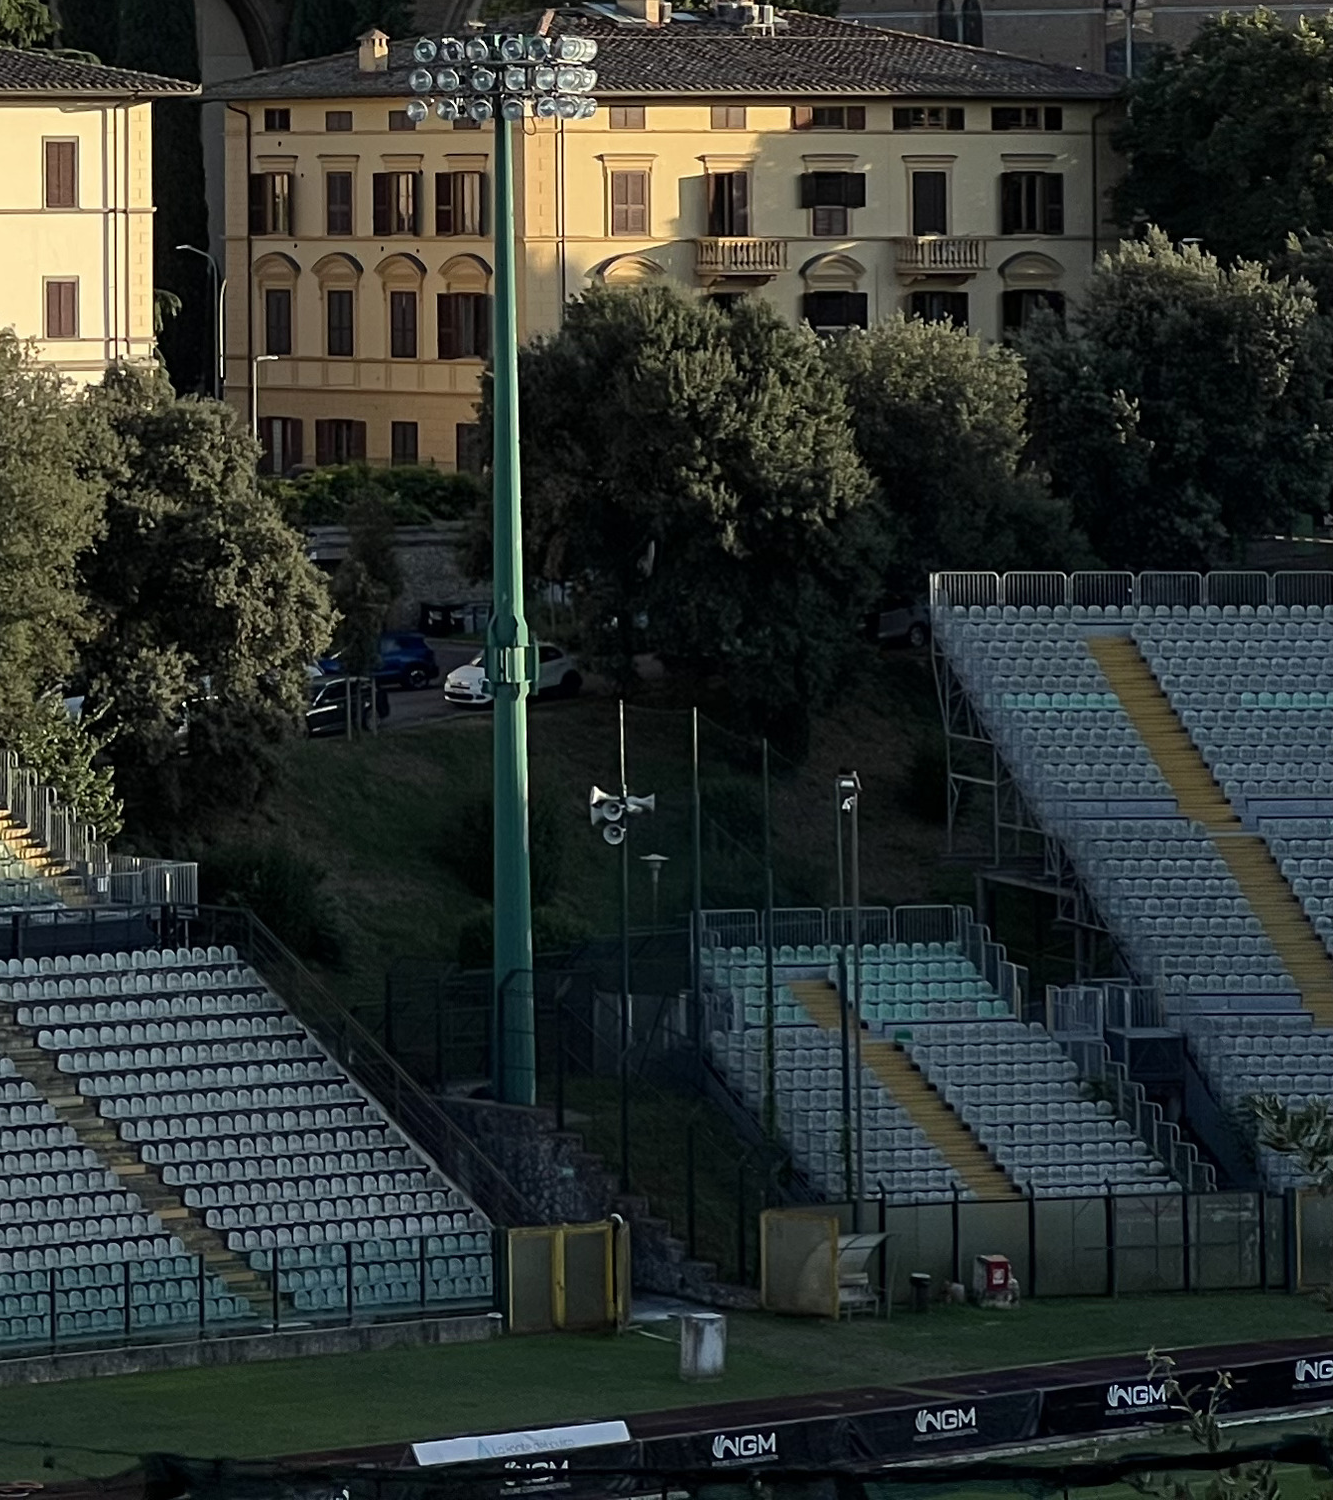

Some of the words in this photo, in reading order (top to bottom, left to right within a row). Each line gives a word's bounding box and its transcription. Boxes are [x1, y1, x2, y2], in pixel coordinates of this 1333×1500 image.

[1106, 1384, 1167, 1408] NGM
[914, 1406, 976, 1433] NGM
[712, 1432, 777, 1459] NGM
